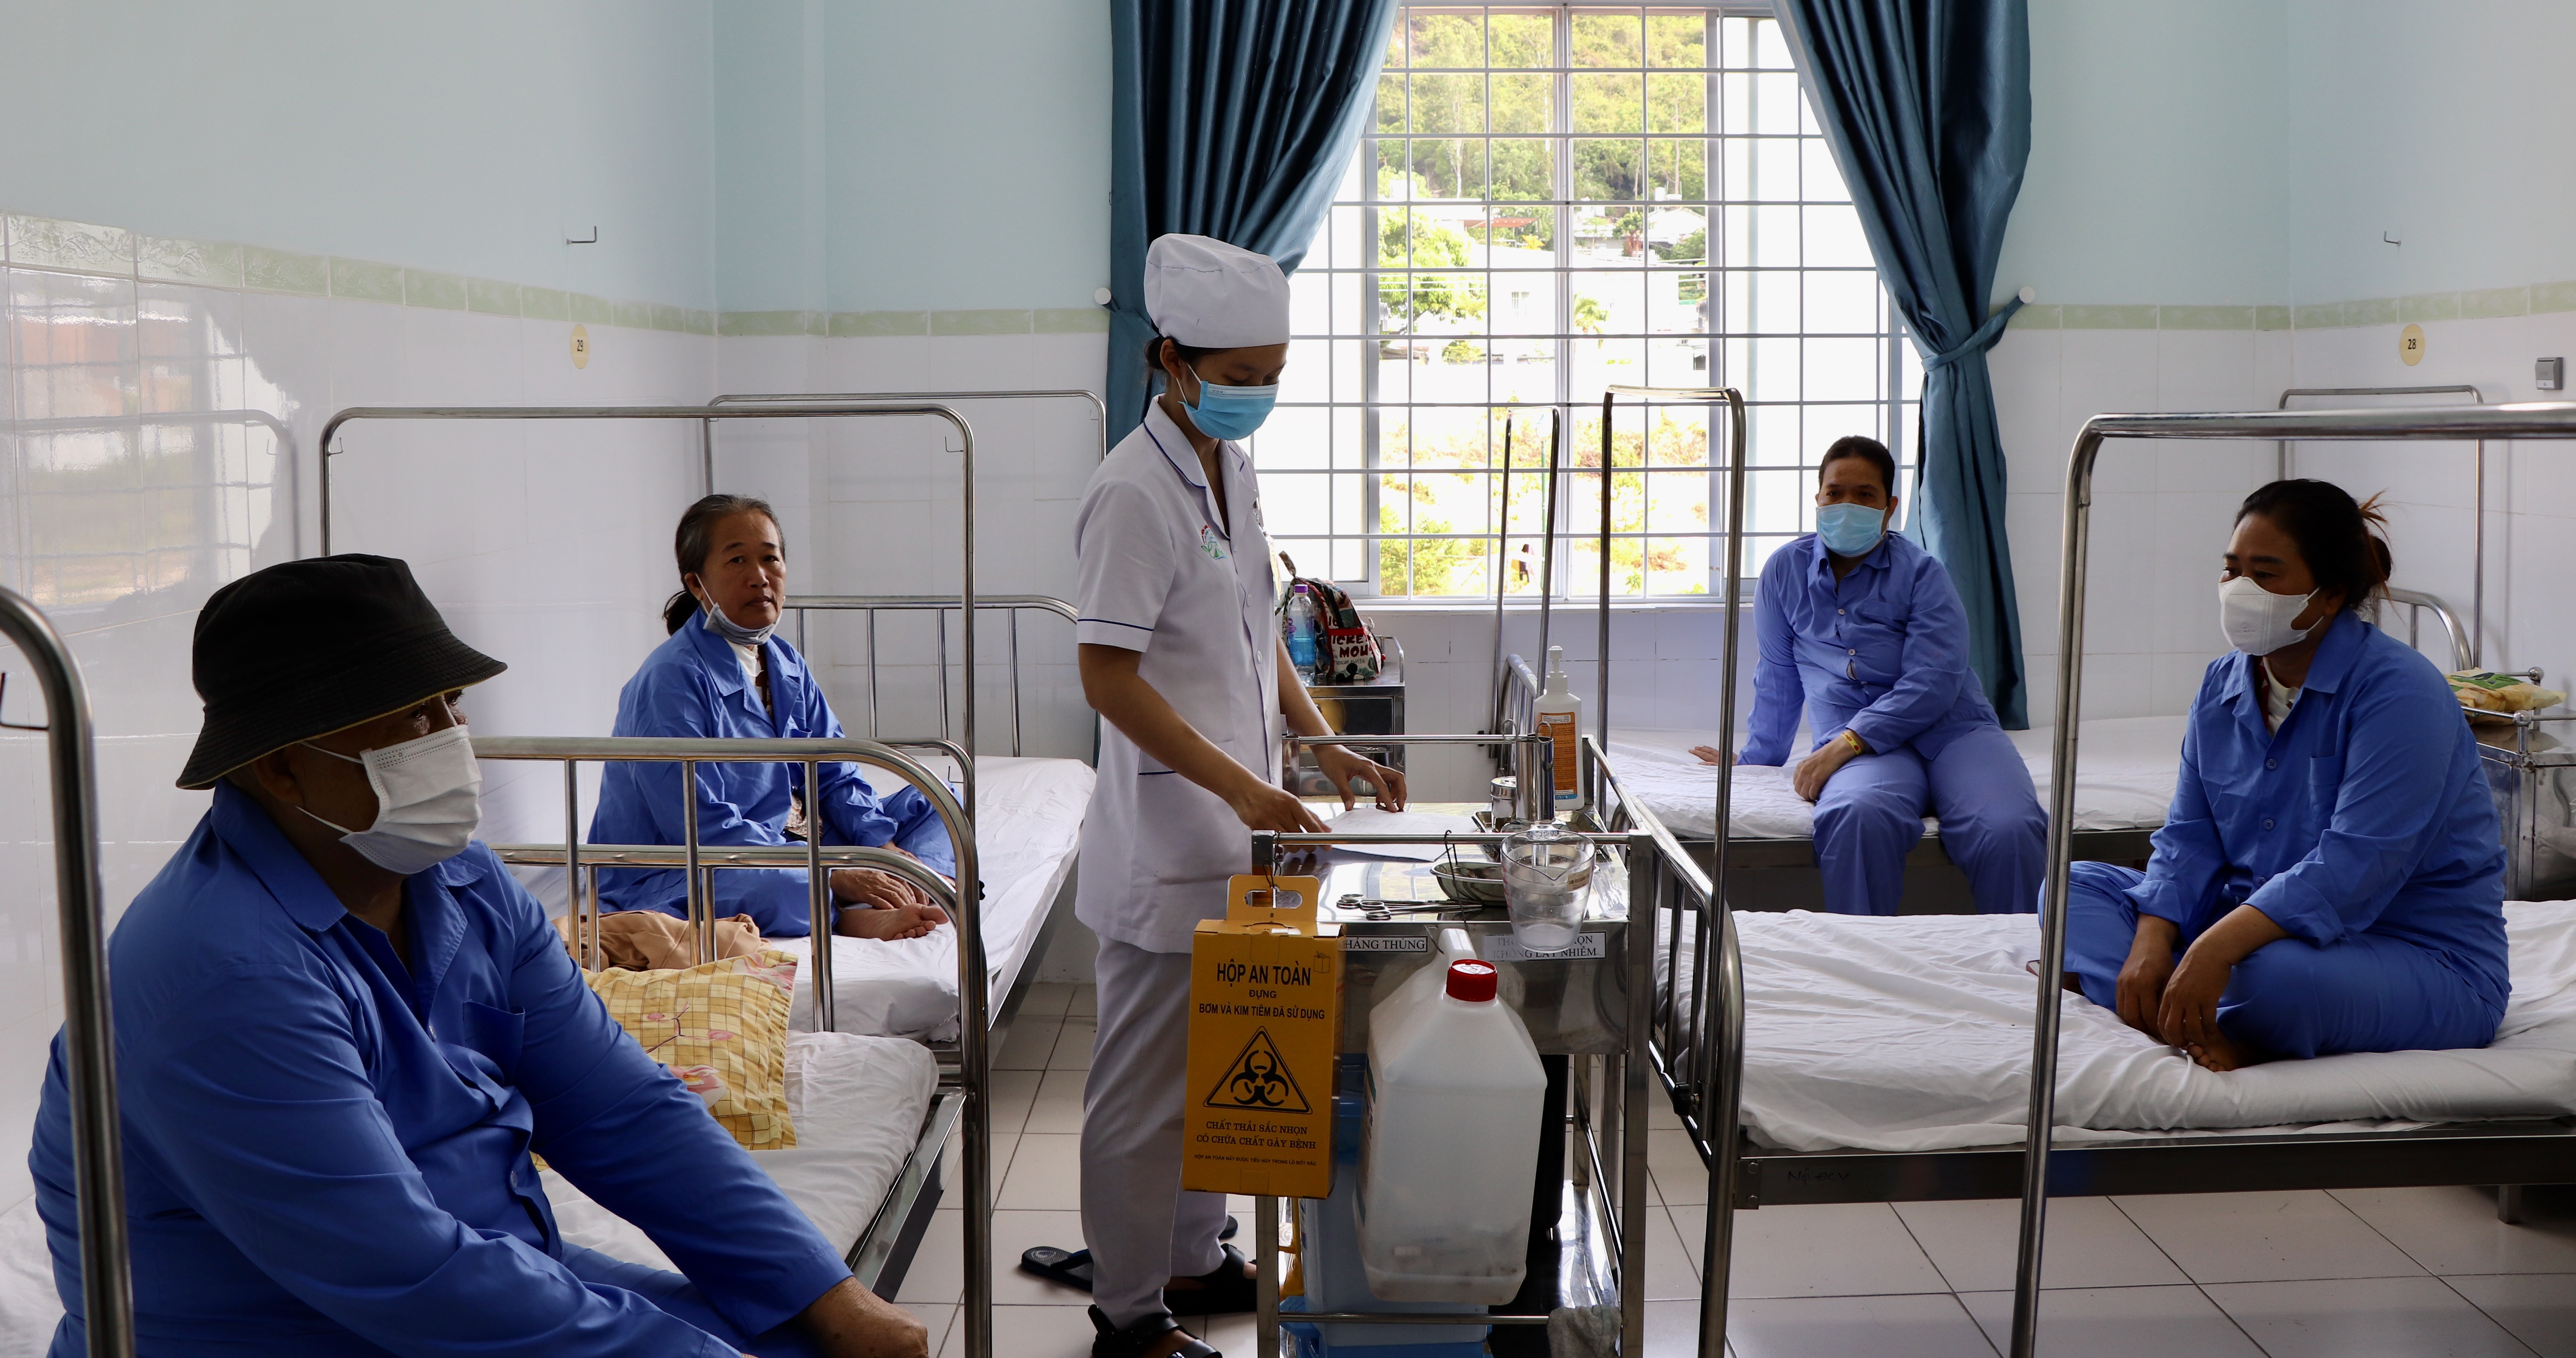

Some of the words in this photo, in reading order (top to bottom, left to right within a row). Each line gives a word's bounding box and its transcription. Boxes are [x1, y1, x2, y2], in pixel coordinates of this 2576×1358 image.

[577, 339, 583, 352] 29
[2408, 338, 2416, 350] 28
[1332, 635, 1368, 645] ICKE
[1345, 938, 1379, 949] HÁNG
[1217, 958, 1246, 987] HỘP
[1249, 965, 1269, 984] AN
[1273, 960, 1311, 986] TOÀN
[1249, 989, 1277, 999] ĐỰNG
[1199, 1003, 1218, 1014] BƠM
[1221, 1002, 1232, 1014] VÀ
[1234, 1005, 1249, 1015] KIM
[1251, 1004, 1270, 1017] TIÊM
[1273, 1006, 1285, 1017] ĐÃ
[1287, 1005, 1299, 1018] SỬ
[1300, 1008, 1325, 1021] DỤNG
[1206, 1118, 1231, 1130] CHẤT
[1233, 1120, 1256, 1132] THẢI
[1258, 1121, 1277, 1133] SẮC
[1279, 1125, 1307, 1136] NHỌN
[1196, 1133, 1209, 1142] CÓ
[1211, 1134, 1236, 1145] CHỨA
[1239, 1135, 1264, 1146] CHẤT
[1267, 1137, 1287, 1147] GÂY
[1289, 1138, 1316, 1150] BỆNH
